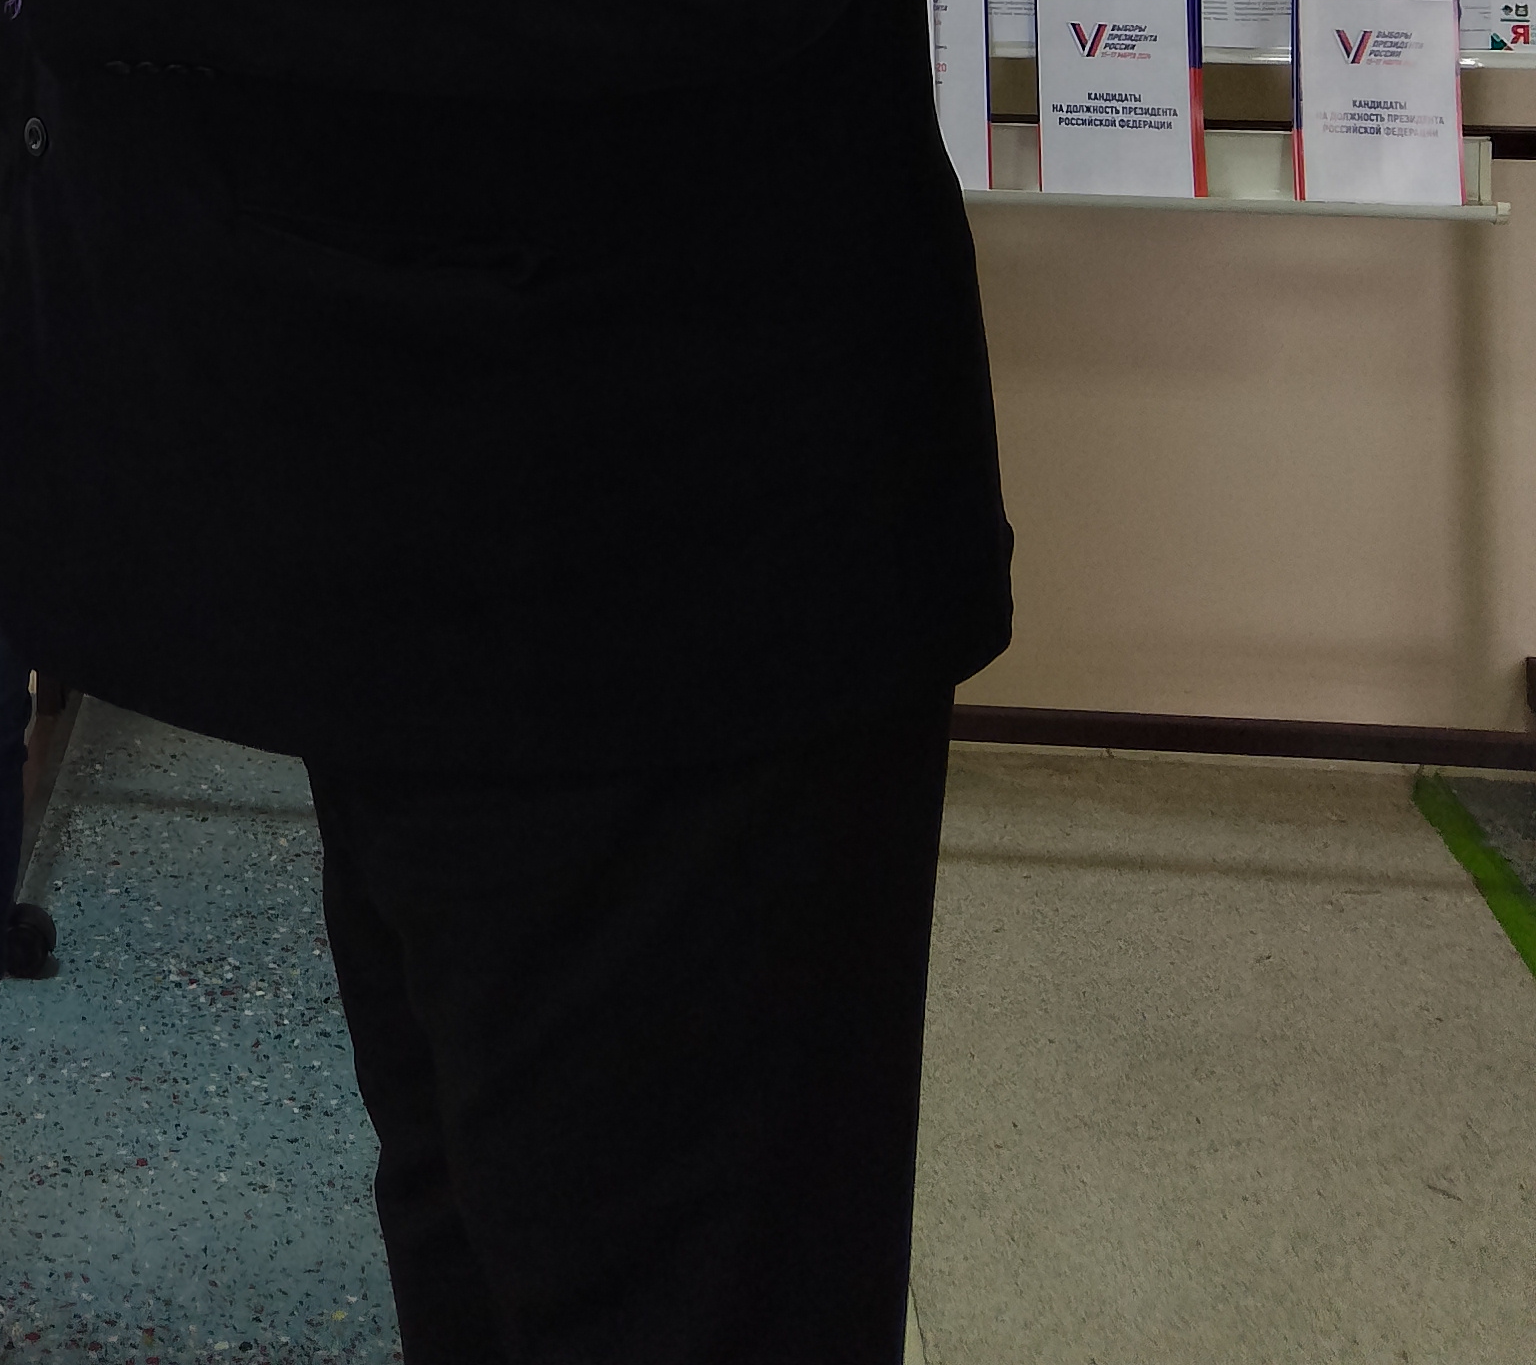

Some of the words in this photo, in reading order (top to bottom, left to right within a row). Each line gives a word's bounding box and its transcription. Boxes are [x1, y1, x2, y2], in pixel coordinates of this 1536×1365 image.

[1111, 24, 1147, 32] ВЫБОРЫ
[1107, 33, 1157, 42] ПРЕЗИДЕНТА
[1087, 92, 1141, 103] КАНДИДАТЫ
[1352, 100, 1407, 110] КАНДИДАТЫ
[1052, 104, 1064, 113] НА
[1066, 105, 1120, 115] ДОЛЖНОСТЬ
[1122, 106, 1178, 117] ПРЕЗИДЕНТА
[1330, 112, 1385, 122] ДОЛЖНОСТЬ
[1058, 116, 1116, 128] РОССИЙСКОЙ
[1118, 118, 1173, 130] ФЕДЕРАЦИИ
[1322, 124, 1381, 135] РОССИЙСКОЙ
